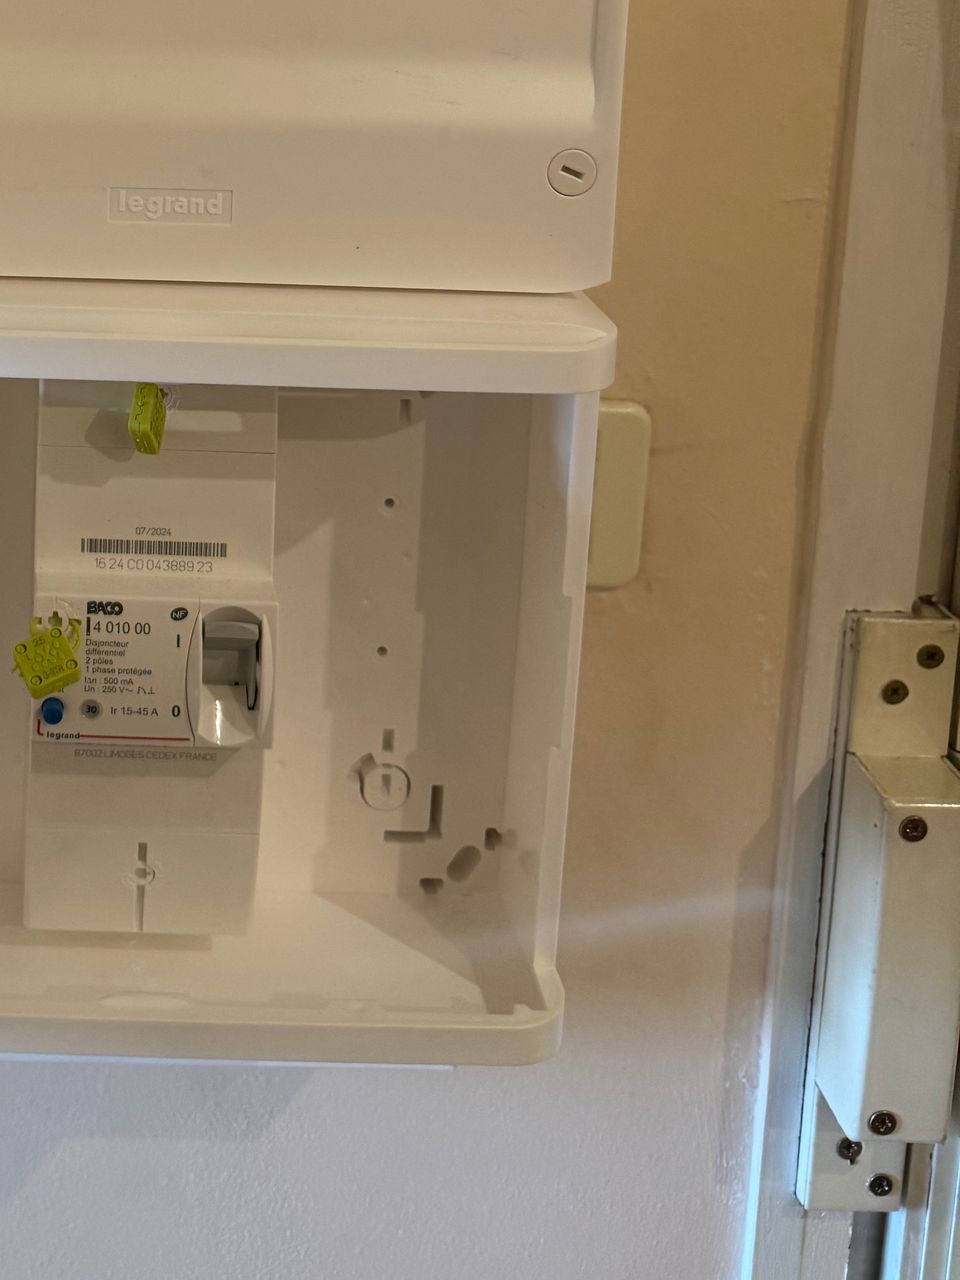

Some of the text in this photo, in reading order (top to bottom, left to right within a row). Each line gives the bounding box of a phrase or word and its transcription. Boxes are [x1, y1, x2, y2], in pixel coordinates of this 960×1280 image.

[119, 190, 223, 220] legrand
[135, 527, 172, 536] 07/2024
[86, 601, 123, 615] BACO
[93, 621, 151, 635] 4 010 00
[85, 639, 129, 649] Disjoncteur
[85, 648, 126, 657] différentiel
[92, 657, 114, 666] pôles
[92, 666, 116, 675] phase
[118, 667, 152, 676] protégée
[103, 677, 118, 685] 500
[102, 685, 117, 693] 250
[85, 705, 97, 714] 30
[120, 707, 149, 716] 15-45
[150, 708, 159, 716] A
[46, 731, 81, 740] legrand
[179, 751, 217, 761] FRANCE
